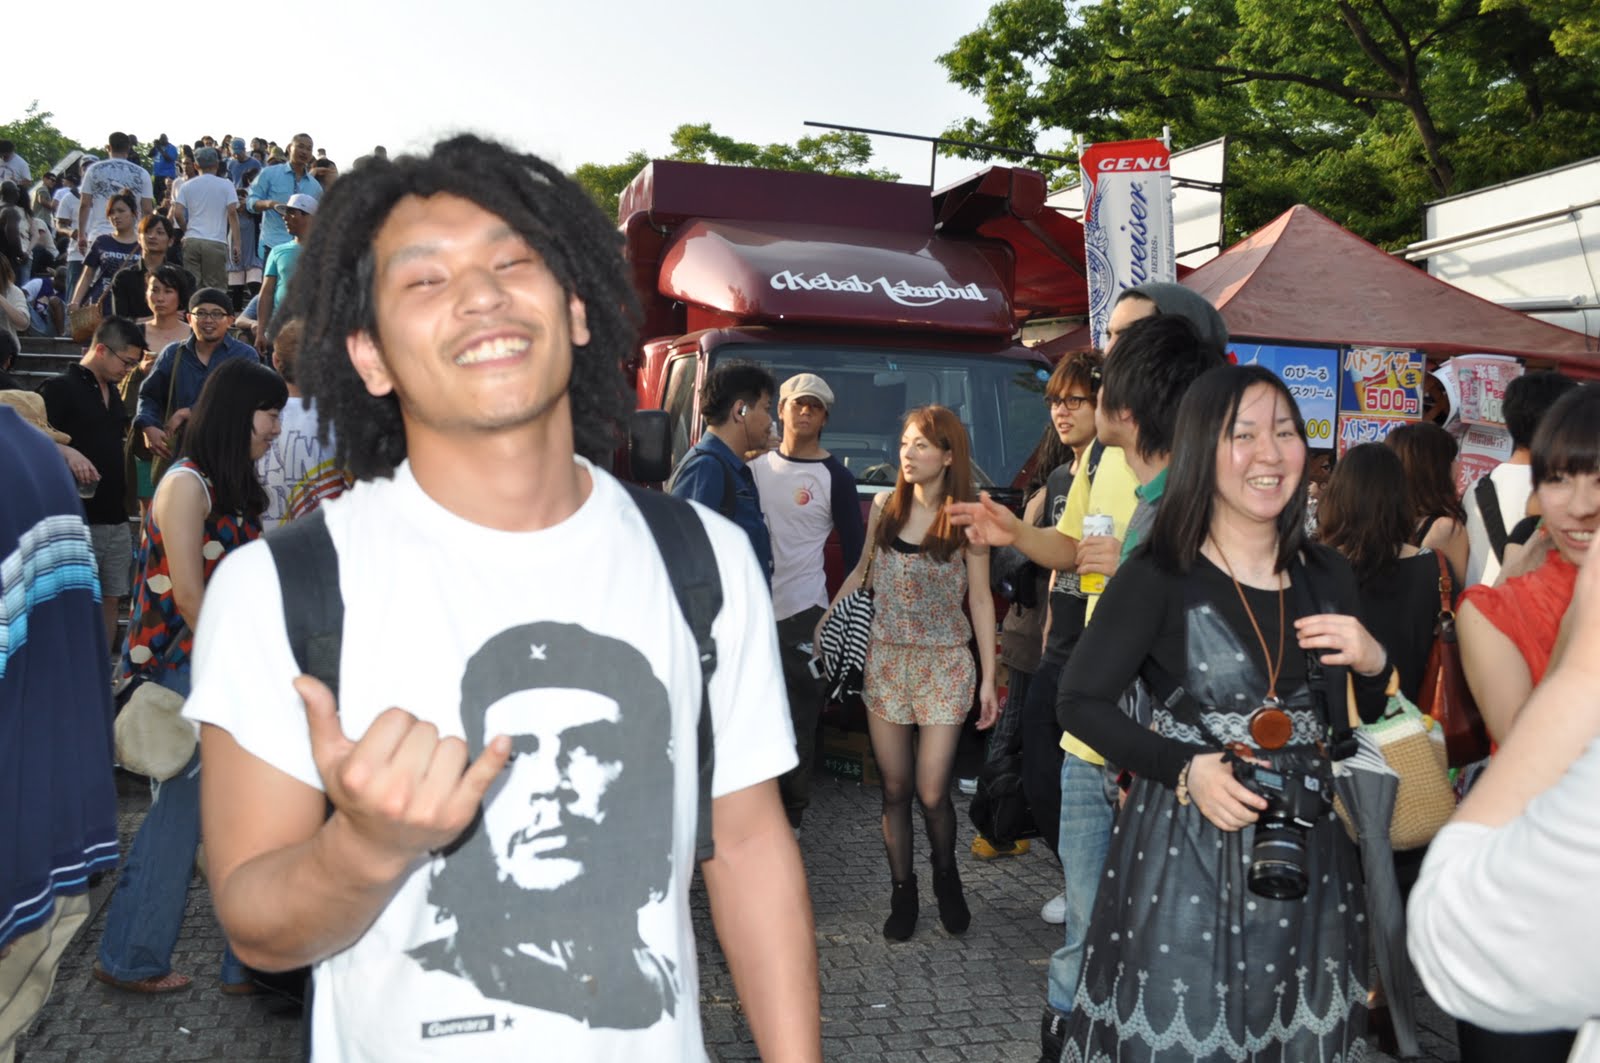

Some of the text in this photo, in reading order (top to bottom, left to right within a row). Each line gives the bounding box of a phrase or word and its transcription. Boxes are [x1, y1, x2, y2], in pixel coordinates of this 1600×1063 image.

[1098, 156, 1169, 171] GENU
[1119, 181, 1148, 289] weiser
[770, 270, 988, 307] Kebab Istanbul
[1344, 350, 1421, 375] バドワイザー
[1405, 371, 1418, 386] 生
[1365, 386, 1417, 414] 500円
